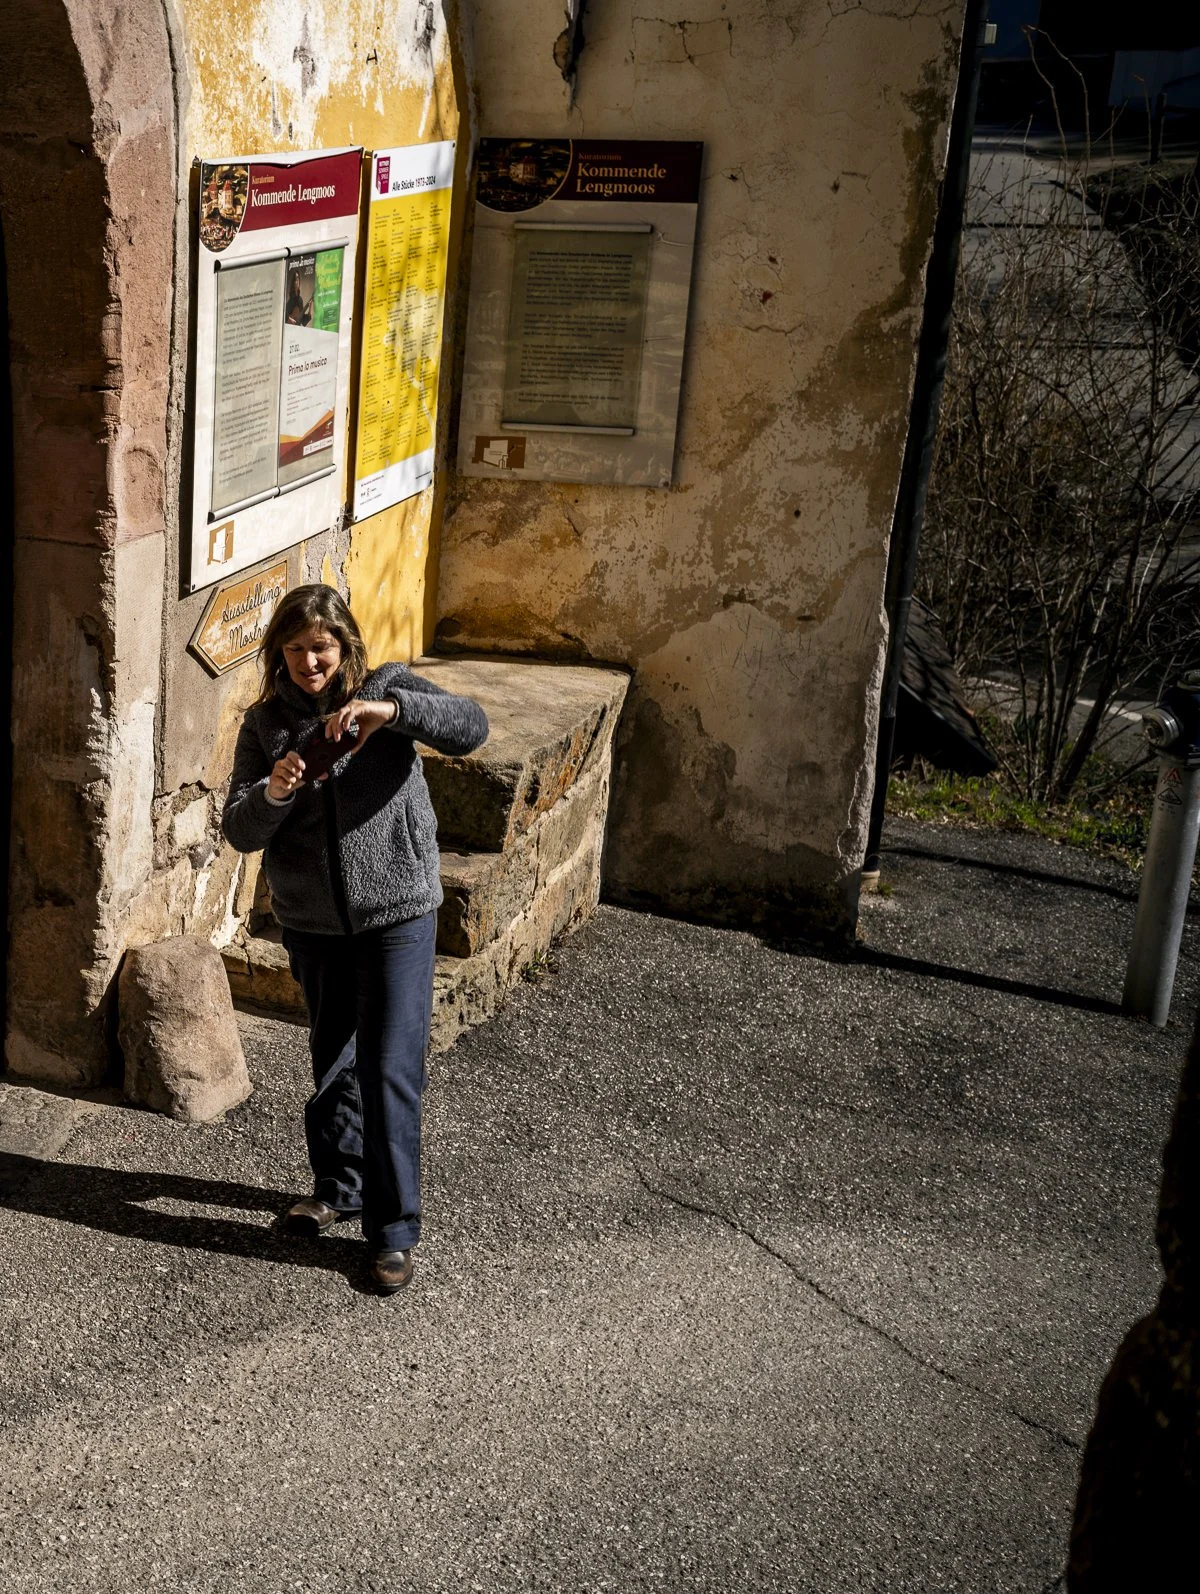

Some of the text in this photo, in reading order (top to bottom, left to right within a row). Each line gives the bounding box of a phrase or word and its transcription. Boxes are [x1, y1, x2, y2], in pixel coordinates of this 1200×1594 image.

[577, 163, 667, 178] Kommende
[392, 180, 401, 192] Alle
[401, 178, 415, 190] Stücke
[576, 179, 656, 197] Lengmoos
[251, 184, 336, 207] Kommende Lengmoos
